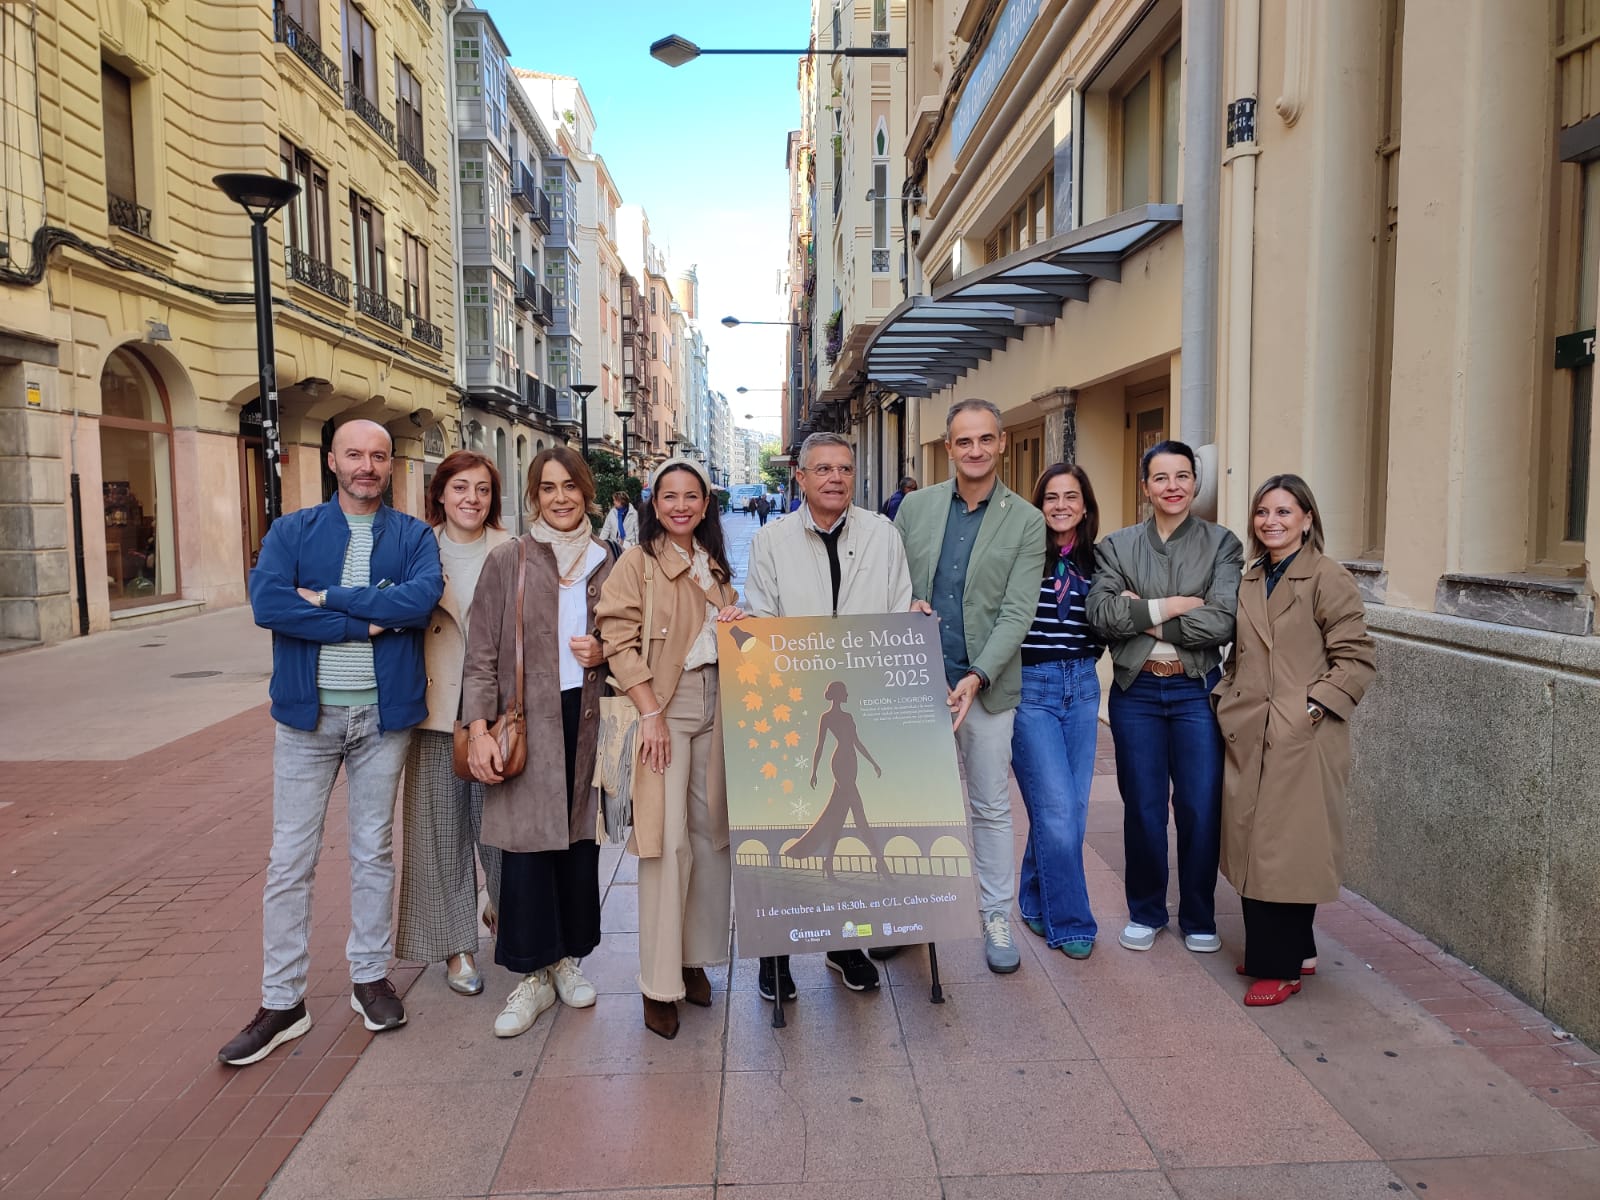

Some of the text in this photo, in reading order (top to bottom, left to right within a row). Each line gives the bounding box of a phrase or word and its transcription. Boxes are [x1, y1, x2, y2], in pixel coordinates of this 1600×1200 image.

[998, 29, 1007, 69] de
[1009, 0, 1037, 47] Berc
[770, 628, 925, 652] Desfile de Moda
[774, 651, 928, 672] Otoño-Invierno
[884, 669, 930, 688] 2025
[863, 697, 892, 706] EDICIÓN
[756, 908, 766, 918] 11
[769, 906, 779, 916] de
[781, 903, 814, 915] octubre
[816, 904, 822, 912] a
[823, 902, 835, 912] las
[837, 900, 868, 911] 18:30h.
[870, 900, 880, 908] en
[904, 895, 928, 906] Calvo
[930, 892, 957, 903] Sotelo
[789, 928, 831, 942] Cámara
[893, 923, 923, 933] Logroño
